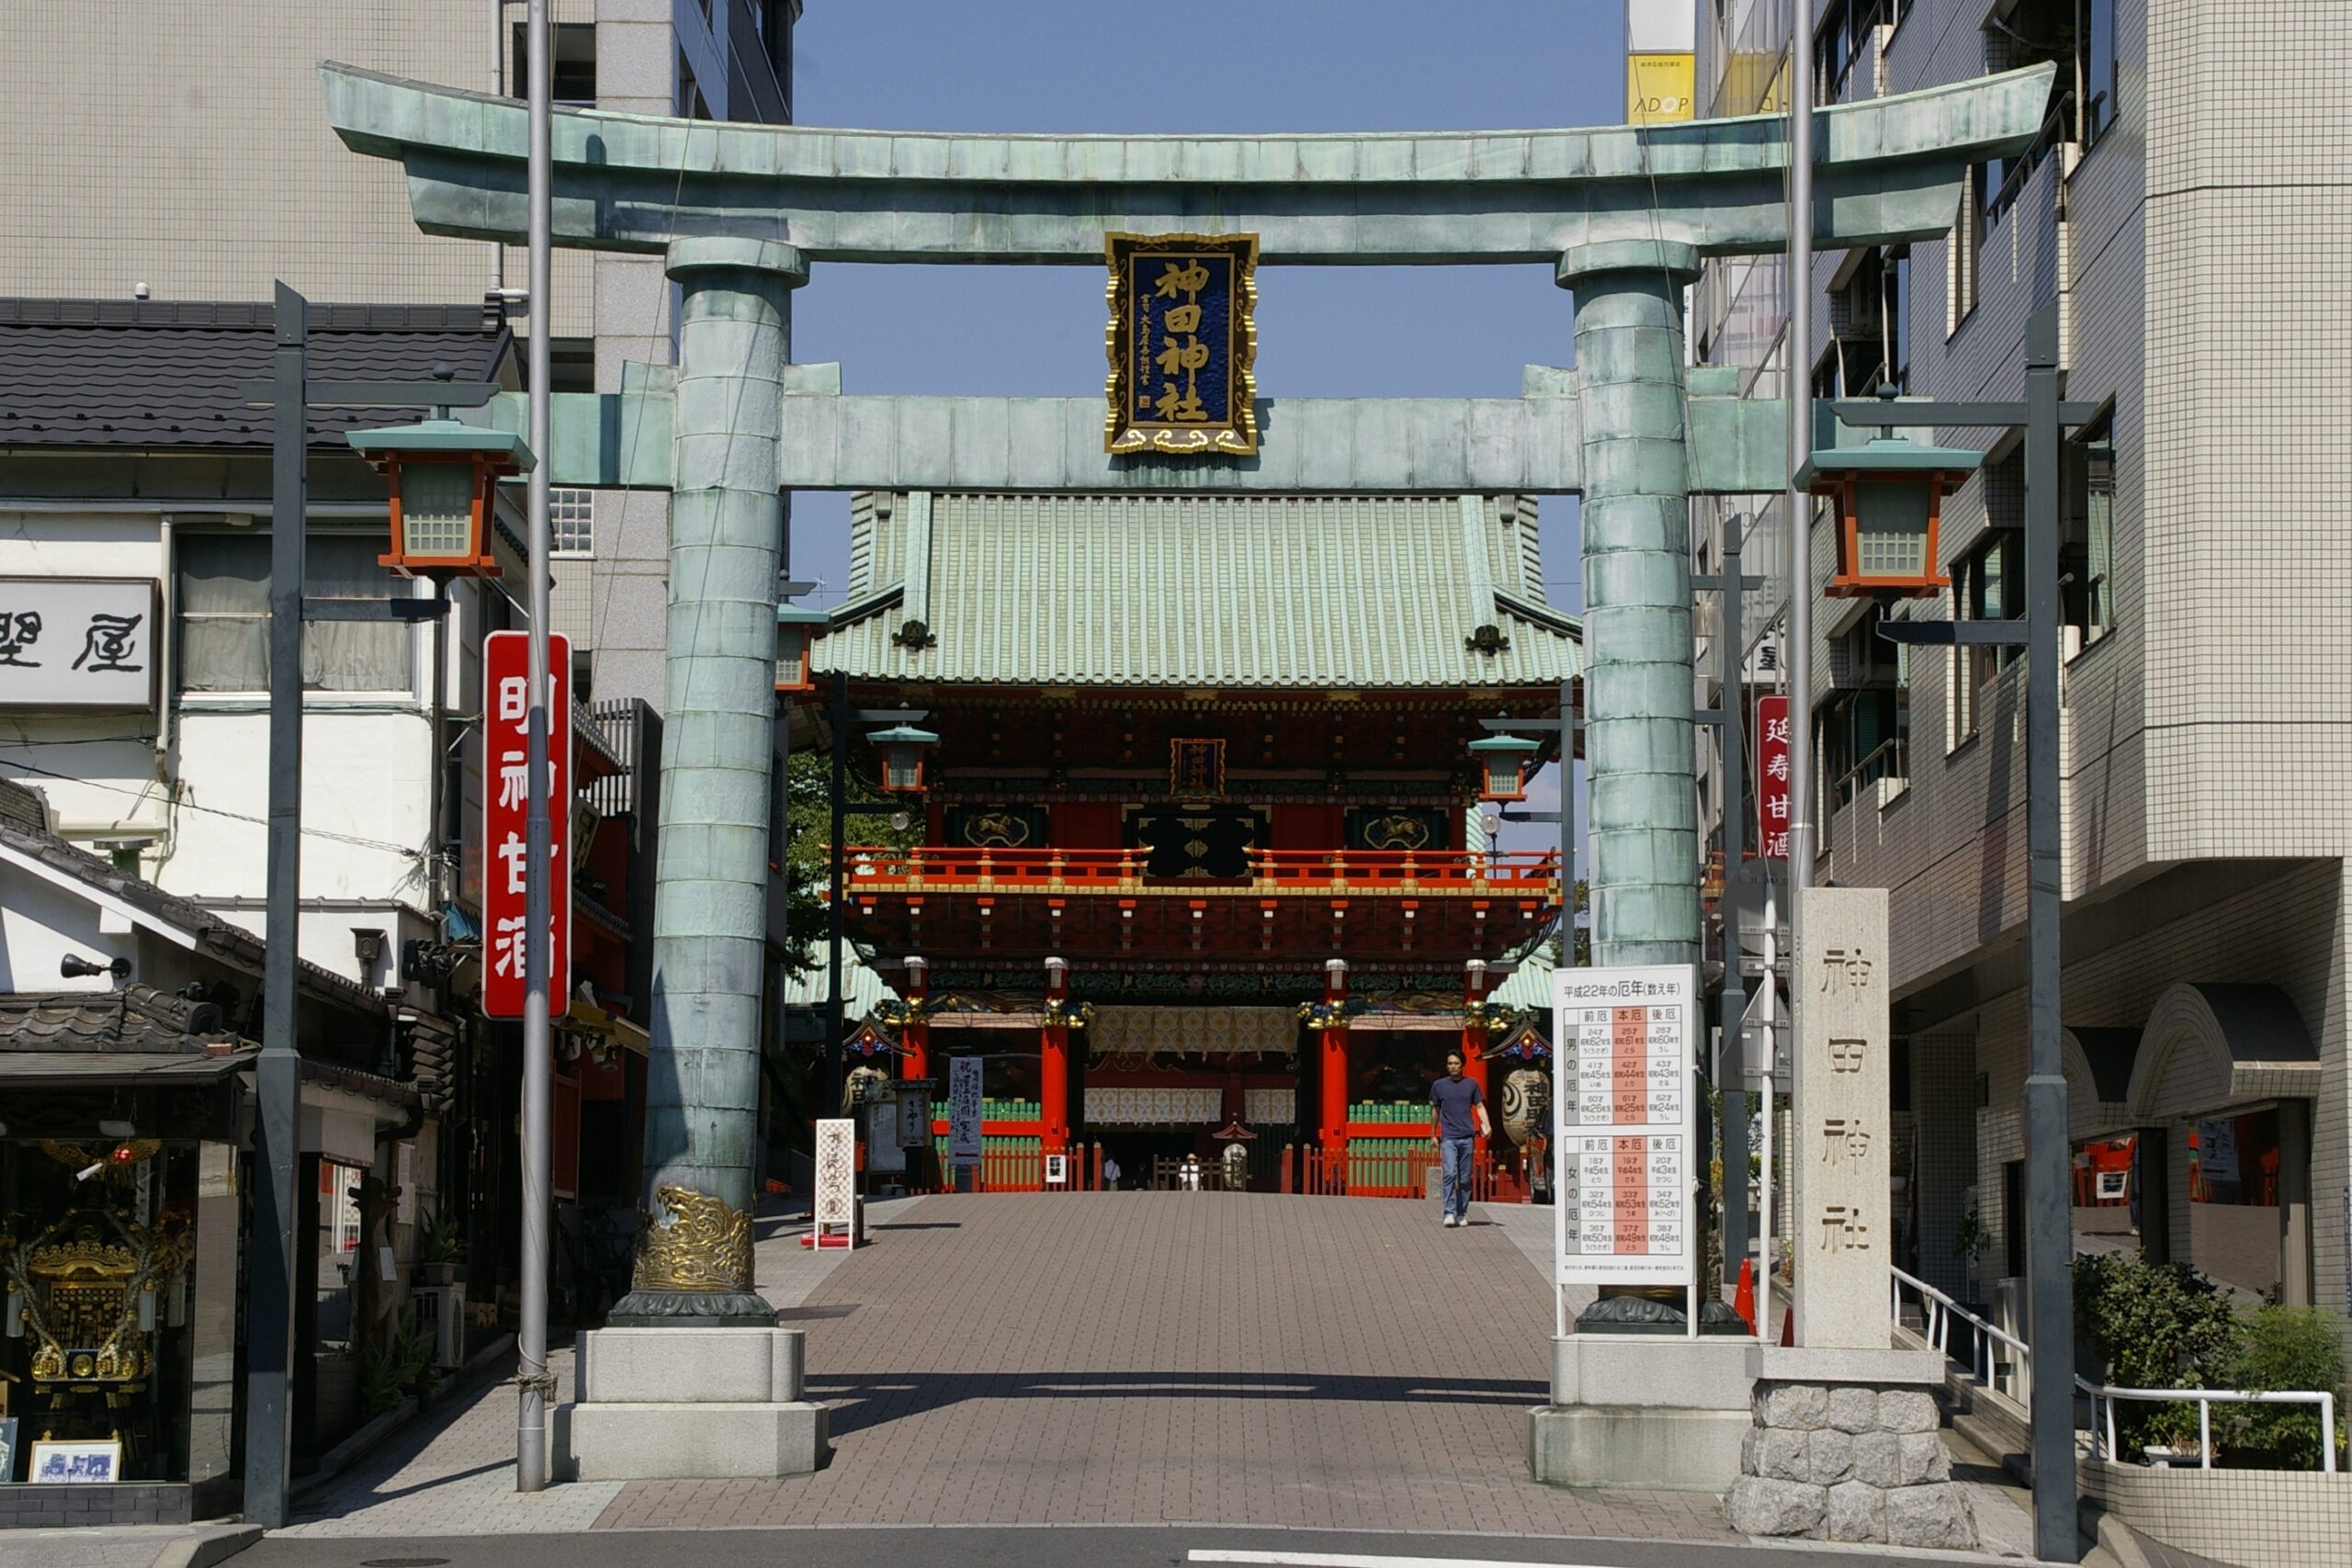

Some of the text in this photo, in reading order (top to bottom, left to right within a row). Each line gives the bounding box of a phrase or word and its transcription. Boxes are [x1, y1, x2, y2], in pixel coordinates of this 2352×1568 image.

[1155, 258, 1210, 422] 神田神社
[1766, 716, 1792, 857] 延寿甘酒
[1564, 980, 1680, 998] 平成22年の厄年(数え年)
[1585, 1010, 1608, 1021] 前厄
[1618, 1010, 1642, 1021] 本厄
[1652, 1009, 1676, 1021] 後厄
[1566, 1039, 1577, 1112] 男の厄年
[1585, 1139, 1608, 1151] 前厄
[1619, 1139, 1642, 1150] 本厄
[1653, 1138, 1676, 1150] 後厄
[1567, 1167, 1577, 1241] 女の厄年
